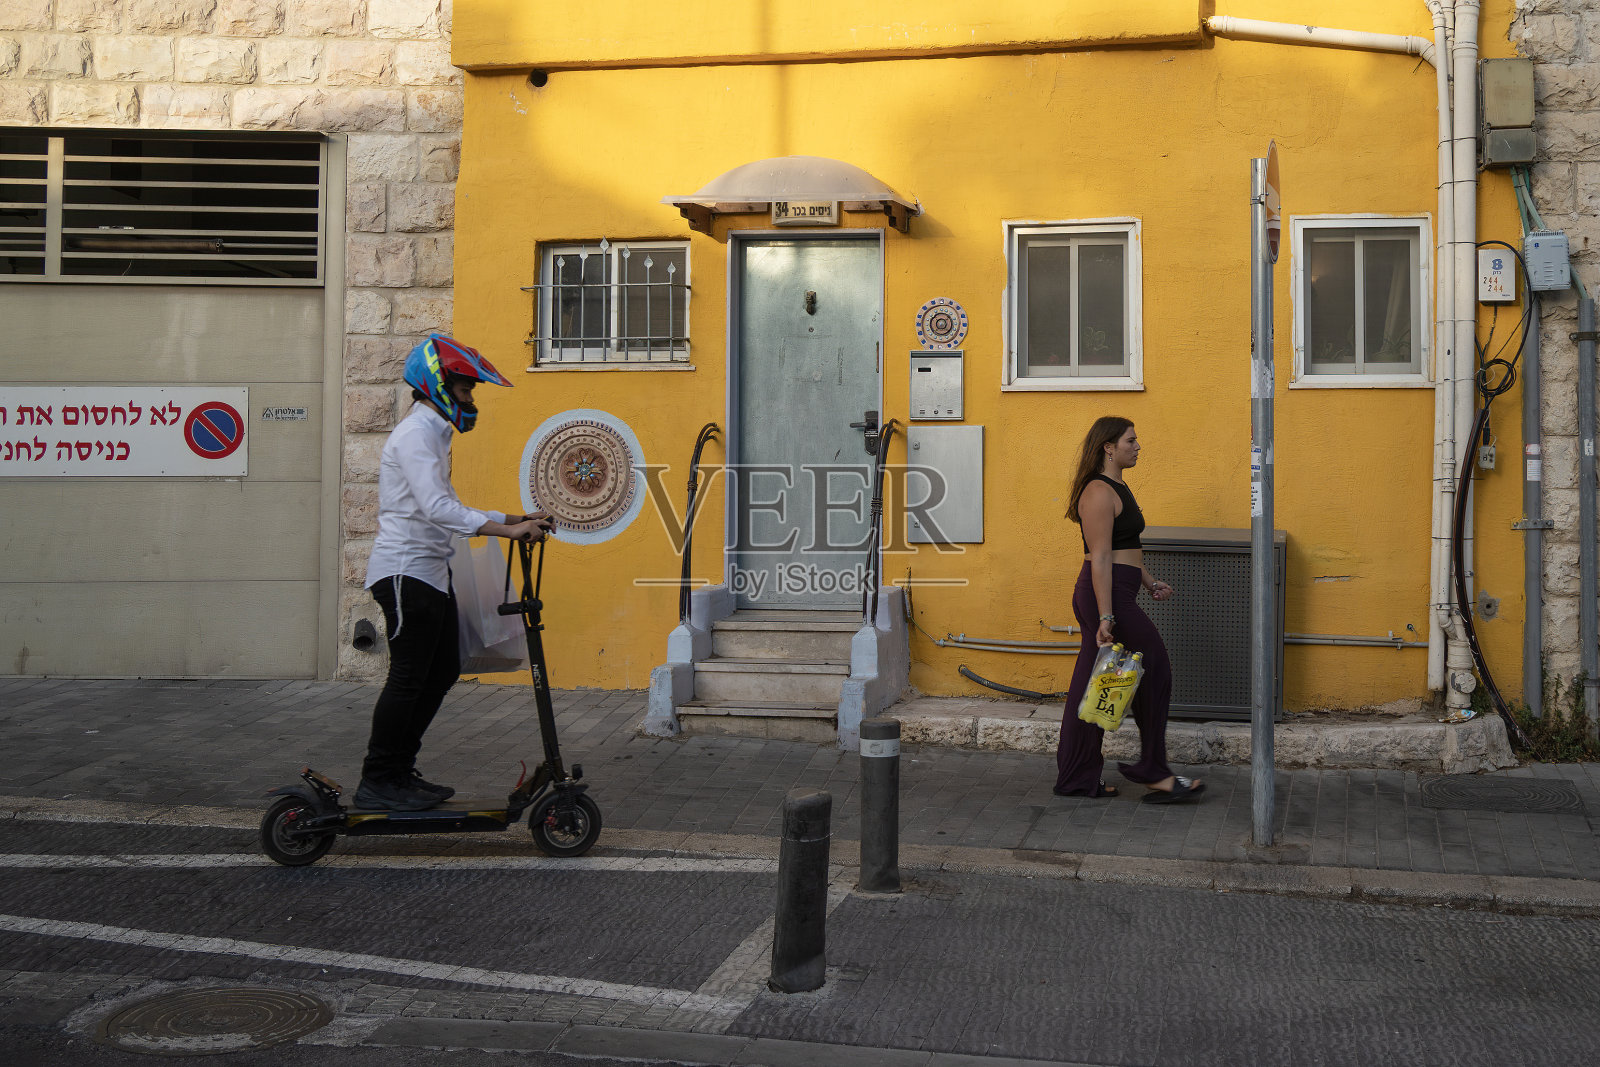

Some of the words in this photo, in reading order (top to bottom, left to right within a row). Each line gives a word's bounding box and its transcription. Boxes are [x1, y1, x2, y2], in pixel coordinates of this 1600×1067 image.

[775, 201, 789, 217] 34
[15, 404, 54, 426] את
[62, 400, 142, 426] לחסום
[150, 400, 181, 426] לא
[56, 440, 130, 461] כניסה
